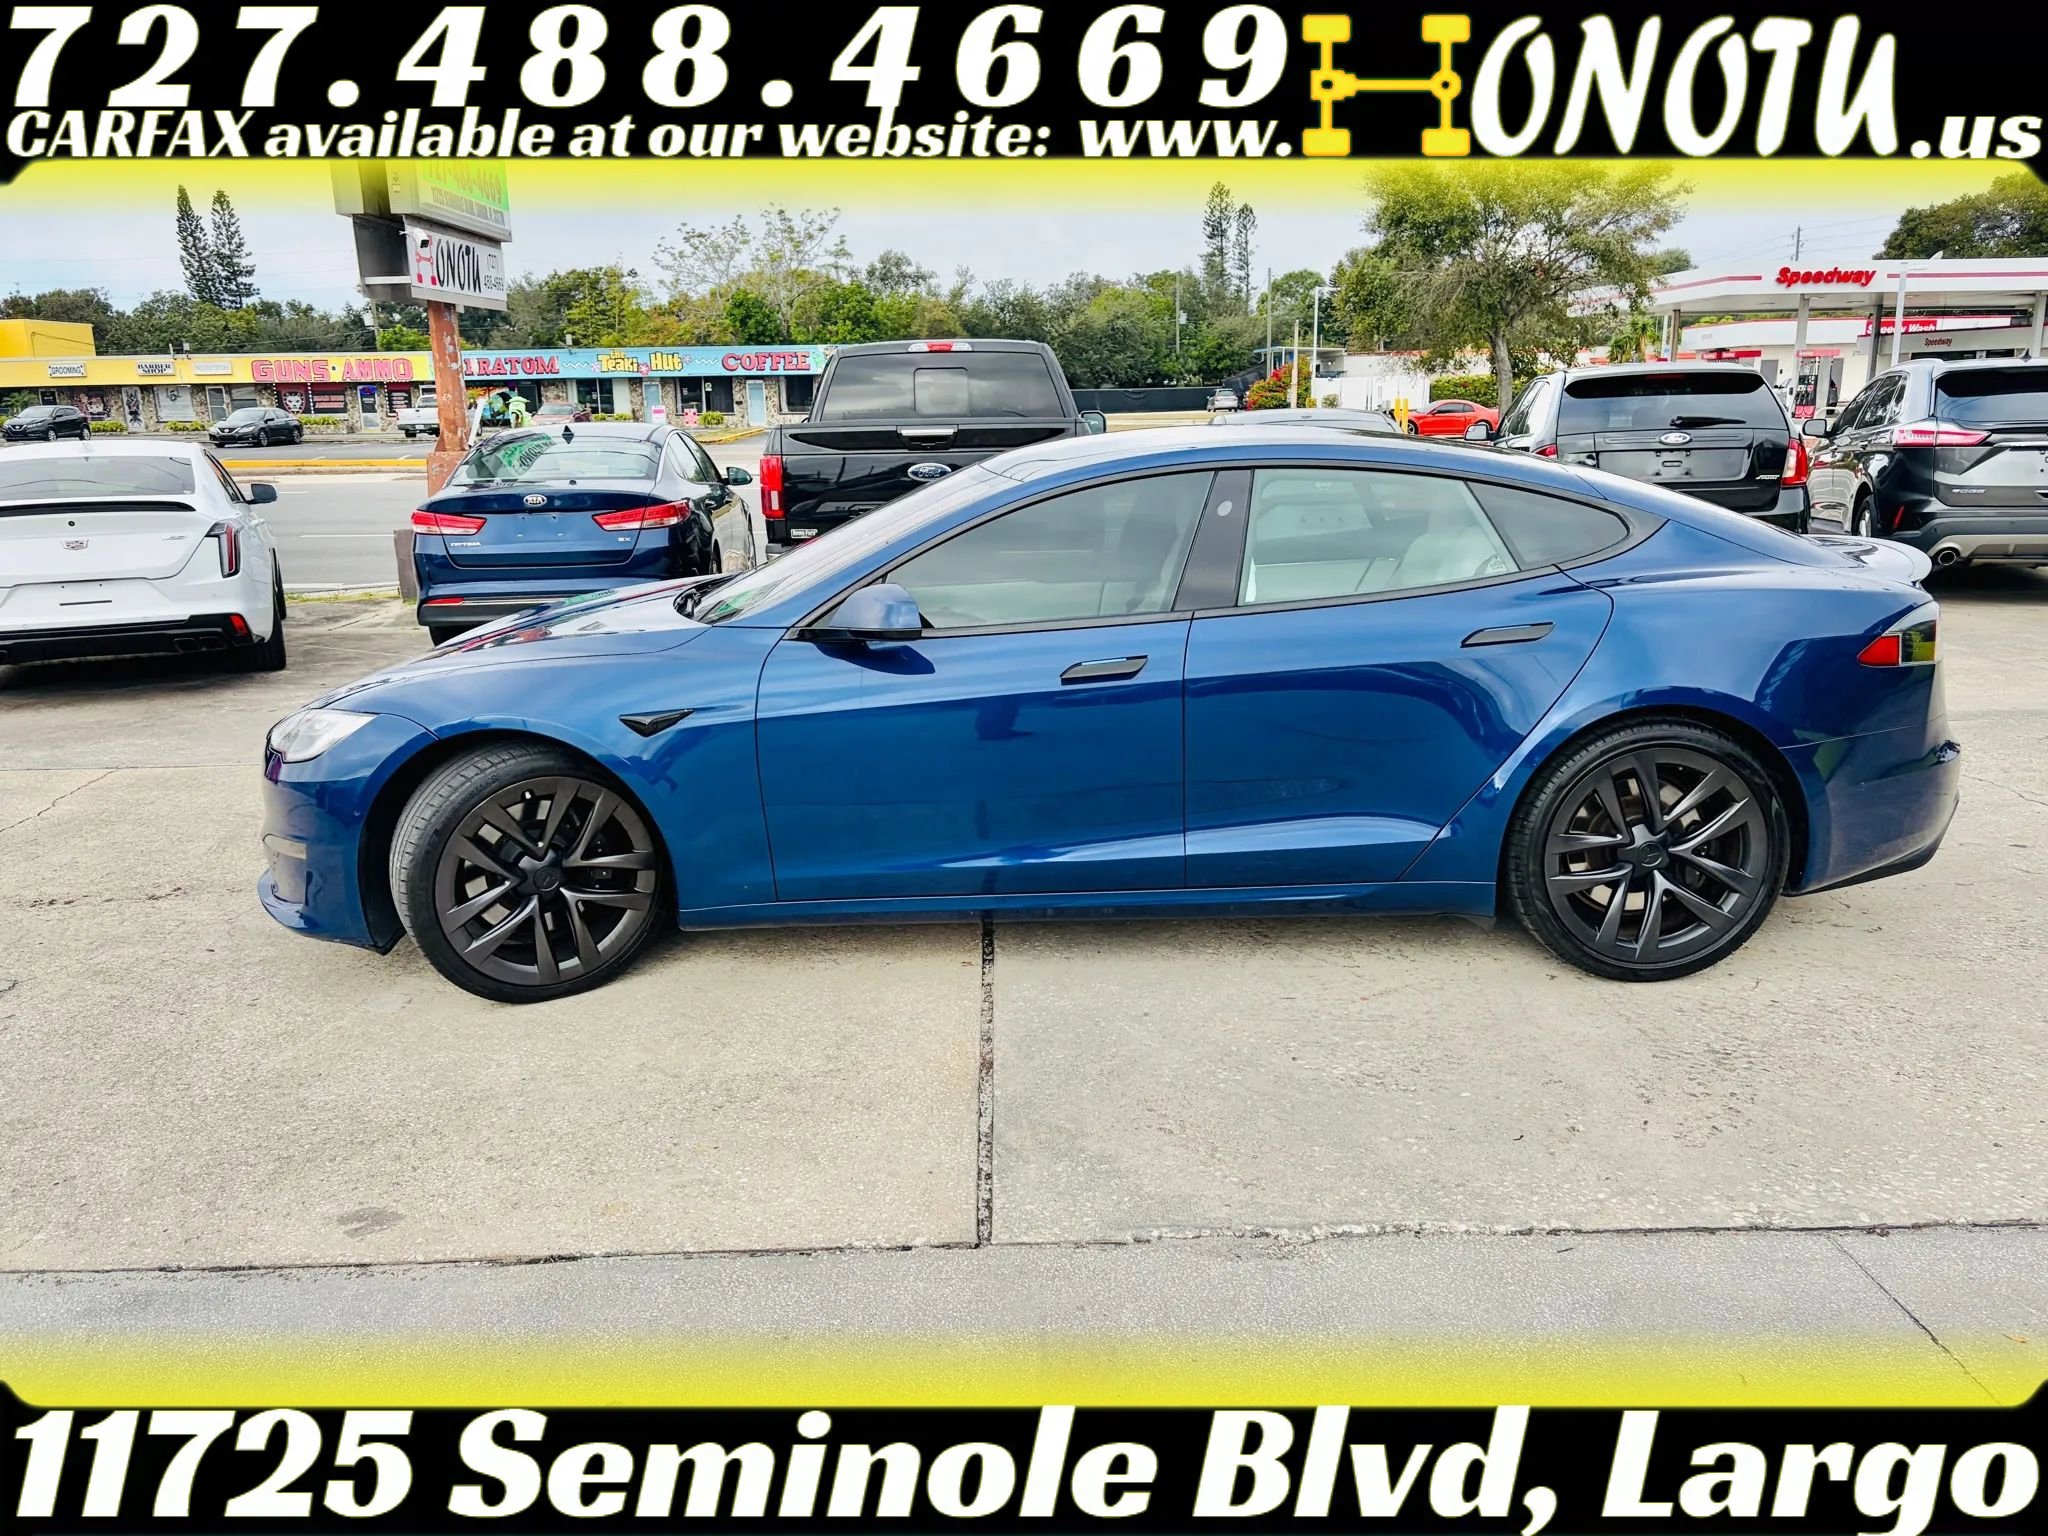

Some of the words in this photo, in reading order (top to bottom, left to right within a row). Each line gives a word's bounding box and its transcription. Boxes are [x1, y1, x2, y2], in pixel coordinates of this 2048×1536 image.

[1776, 266, 1877, 288] Speedway
[51, 366, 82, 375] GROOMING
[251, 359, 332, 383] GUNS
[342, 357, 414, 382] AMMO
[597, 352, 640, 373] Teaki
[649, 351, 684, 372] Hut
[721, 351, 811, 372] COFFEE
[527, 496, 544, 505] KIA
